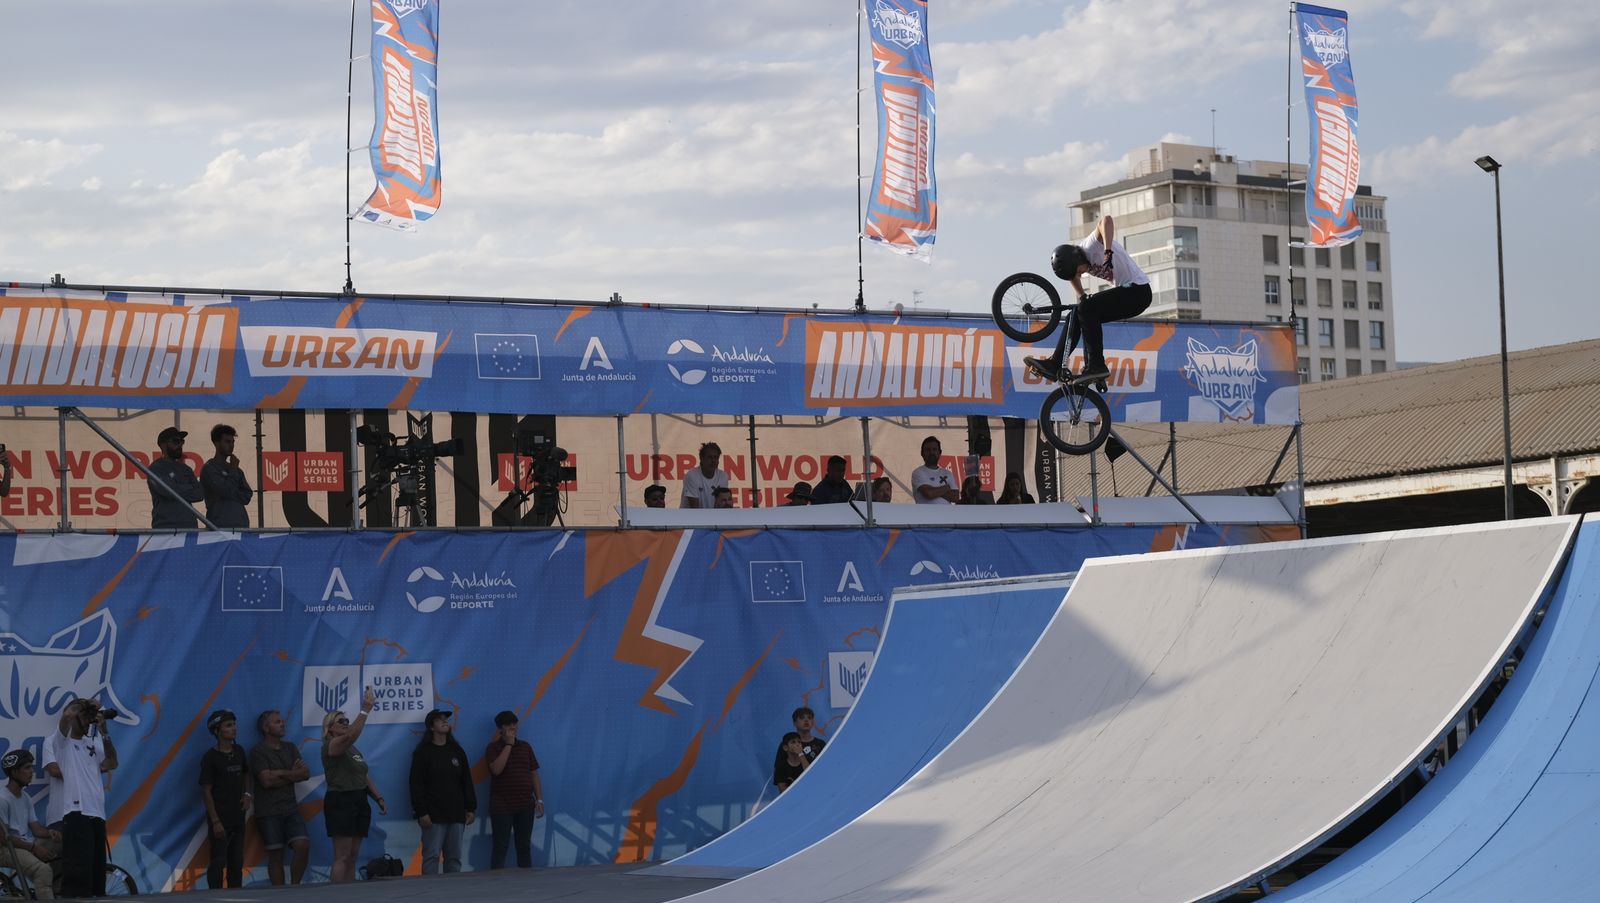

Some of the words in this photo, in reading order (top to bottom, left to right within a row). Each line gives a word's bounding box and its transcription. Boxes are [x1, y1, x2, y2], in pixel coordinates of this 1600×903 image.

[262, 334, 425, 370] URBAN
[711, 344, 775, 365] Andalucía
[810, 328, 994, 400] ANDALUCÍA
[562, 374, 583, 382] Junta
[712, 375, 756, 383] DEPORTE
[1202, 382, 1253, 400] URBAN
[303, 459, 337, 467] URBAN
[1041, 450, 1051, 489] URBAN
[303, 476, 338, 484] SERIES
[949, 564, 1000, 581] Andalucía
[450, 571, 516, 589] Andalucía
[824, 595, 841, 603] Junta
[304, 604, 325, 612] Junta
[326, 603, 336, 612] de
[450, 601, 494, 609] DEPORTE
[373, 676, 422, 686] URBAN
[374, 688, 423, 698] WORLD
[373, 700, 424, 711] SERIES
